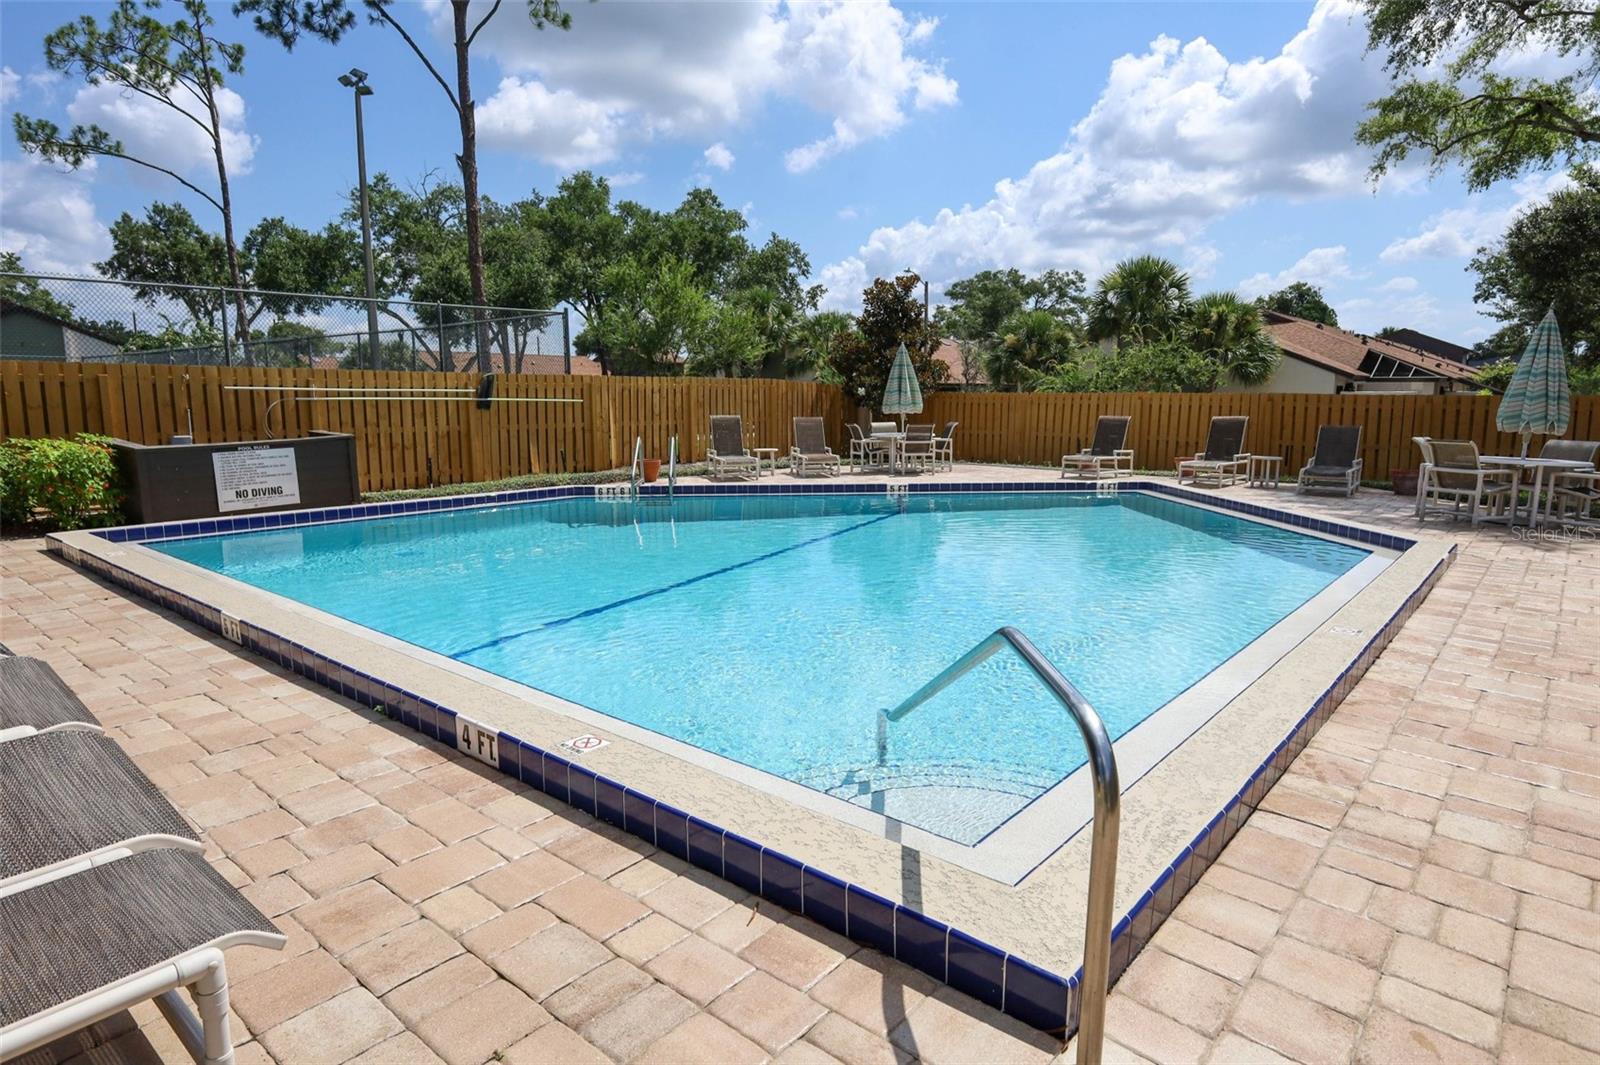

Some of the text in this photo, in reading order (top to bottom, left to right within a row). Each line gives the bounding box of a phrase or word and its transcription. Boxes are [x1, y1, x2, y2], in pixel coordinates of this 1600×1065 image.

[235, 486, 283, 499] NO DIVING
[597, 487, 604, 496] 6
[606, 487, 617, 496] FT
[889, 484, 908, 493] 5 FT
[462, 724, 472, 750] 4
